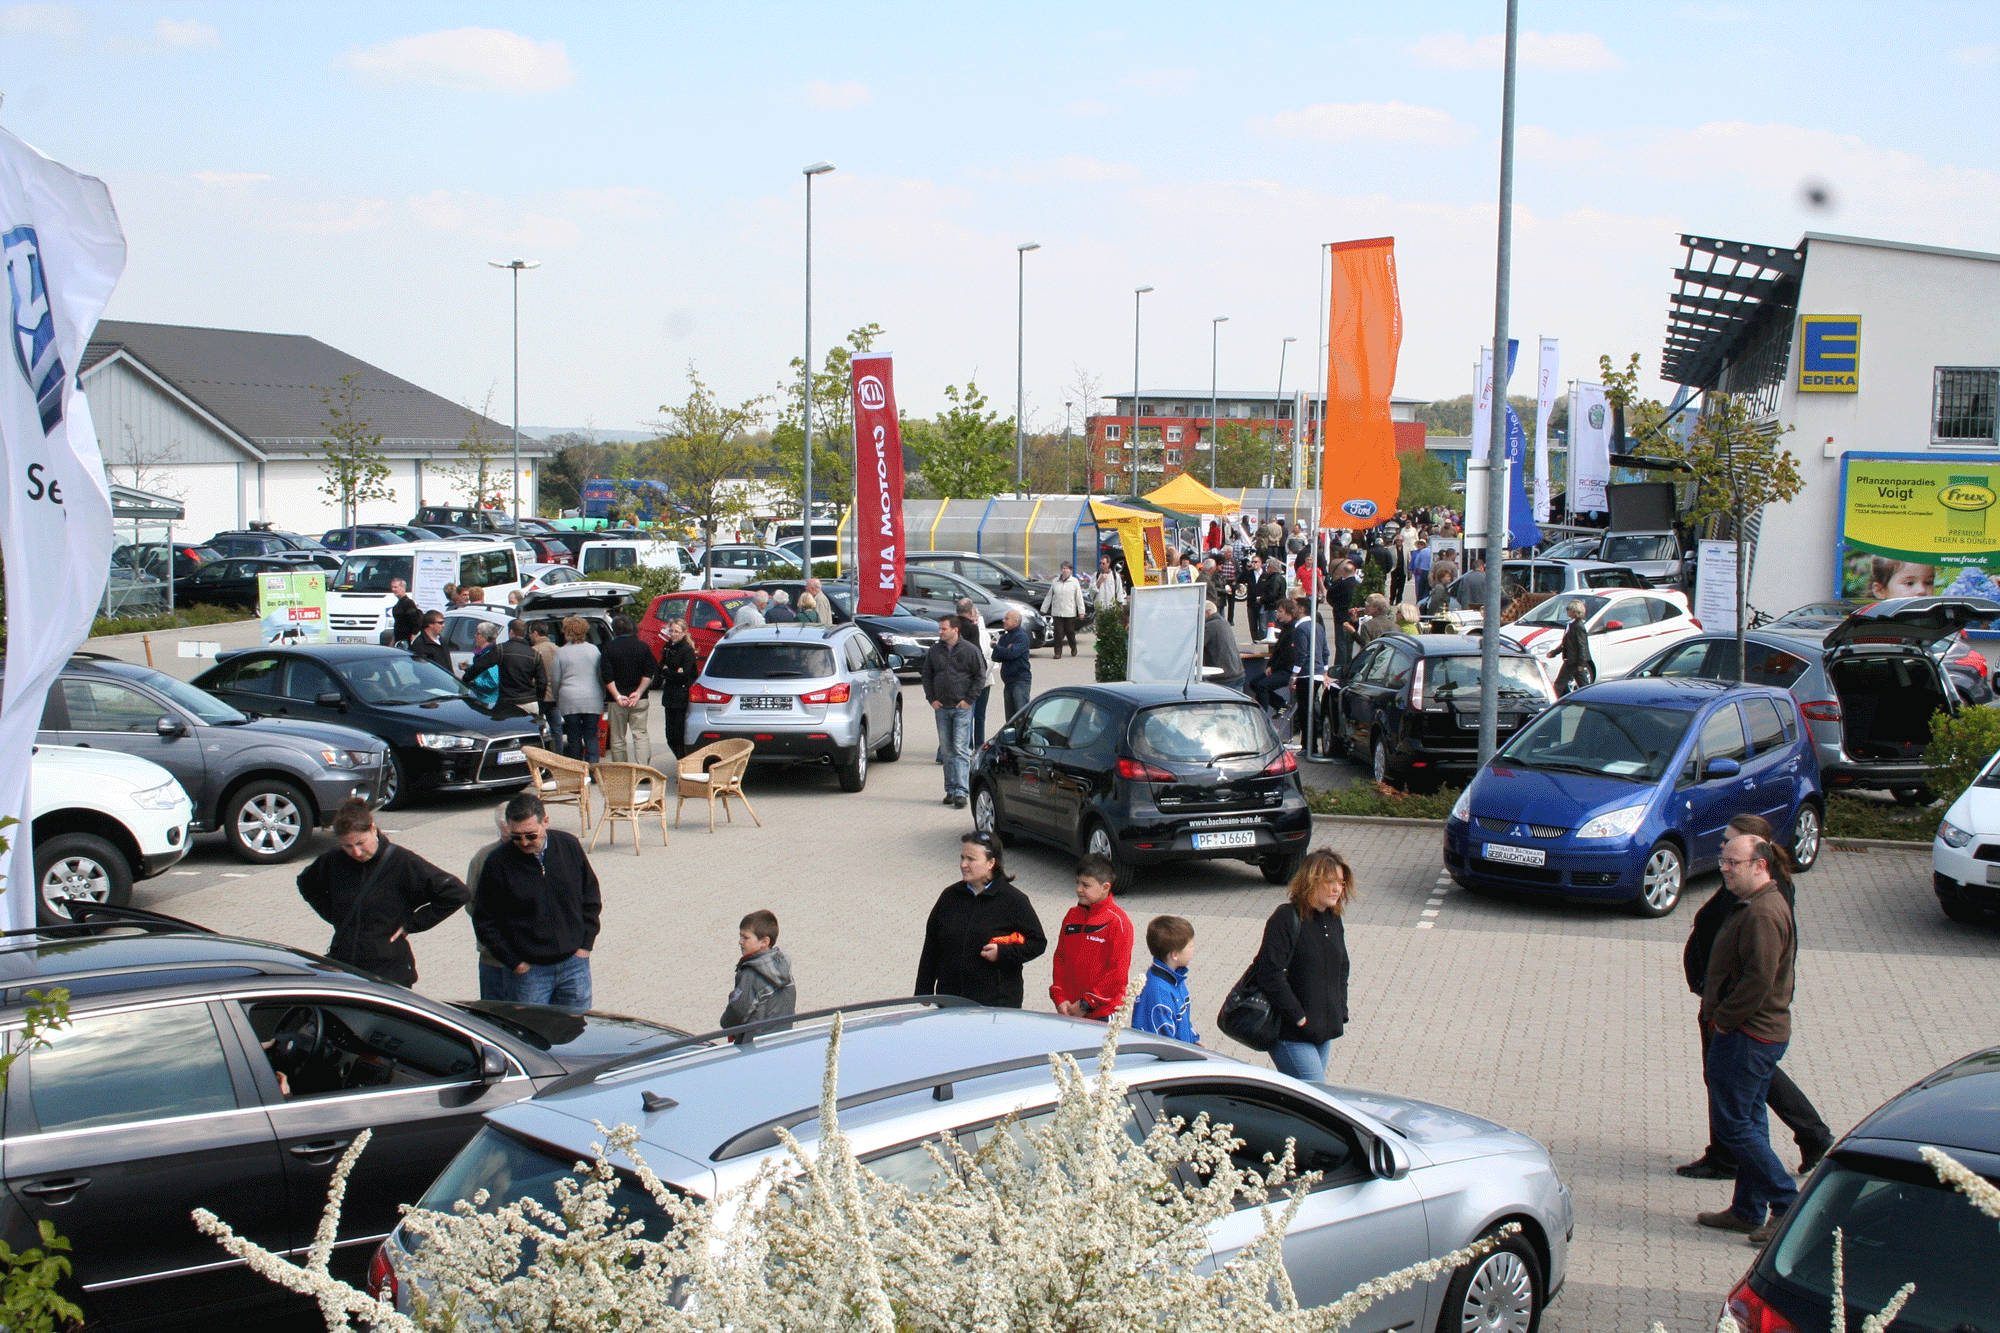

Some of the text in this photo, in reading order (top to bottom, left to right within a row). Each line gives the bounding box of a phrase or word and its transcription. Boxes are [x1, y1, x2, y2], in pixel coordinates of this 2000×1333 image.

[1803, 376, 1856, 386] EDEKA
[1510, 437, 1518, 464] Feel
[1856, 476, 1936, 487] Pflanzenparadies
[1878, 487, 1913, 501] Voigt
[1947, 488, 1985, 502] frux
[873, 425, 895, 589] KIA MOTORS
[1350, 502, 1372, 516] Ford
[1941, 556, 1988, 565] www.frux.de
[1189, 815, 1262, 827] www.bachmann-auto.de
[1200, 834, 1213, 845] PF
[1228, 832, 1253, 844] 6667
[1488, 850, 1544, 864] GEBRAUCHTWAGEN
